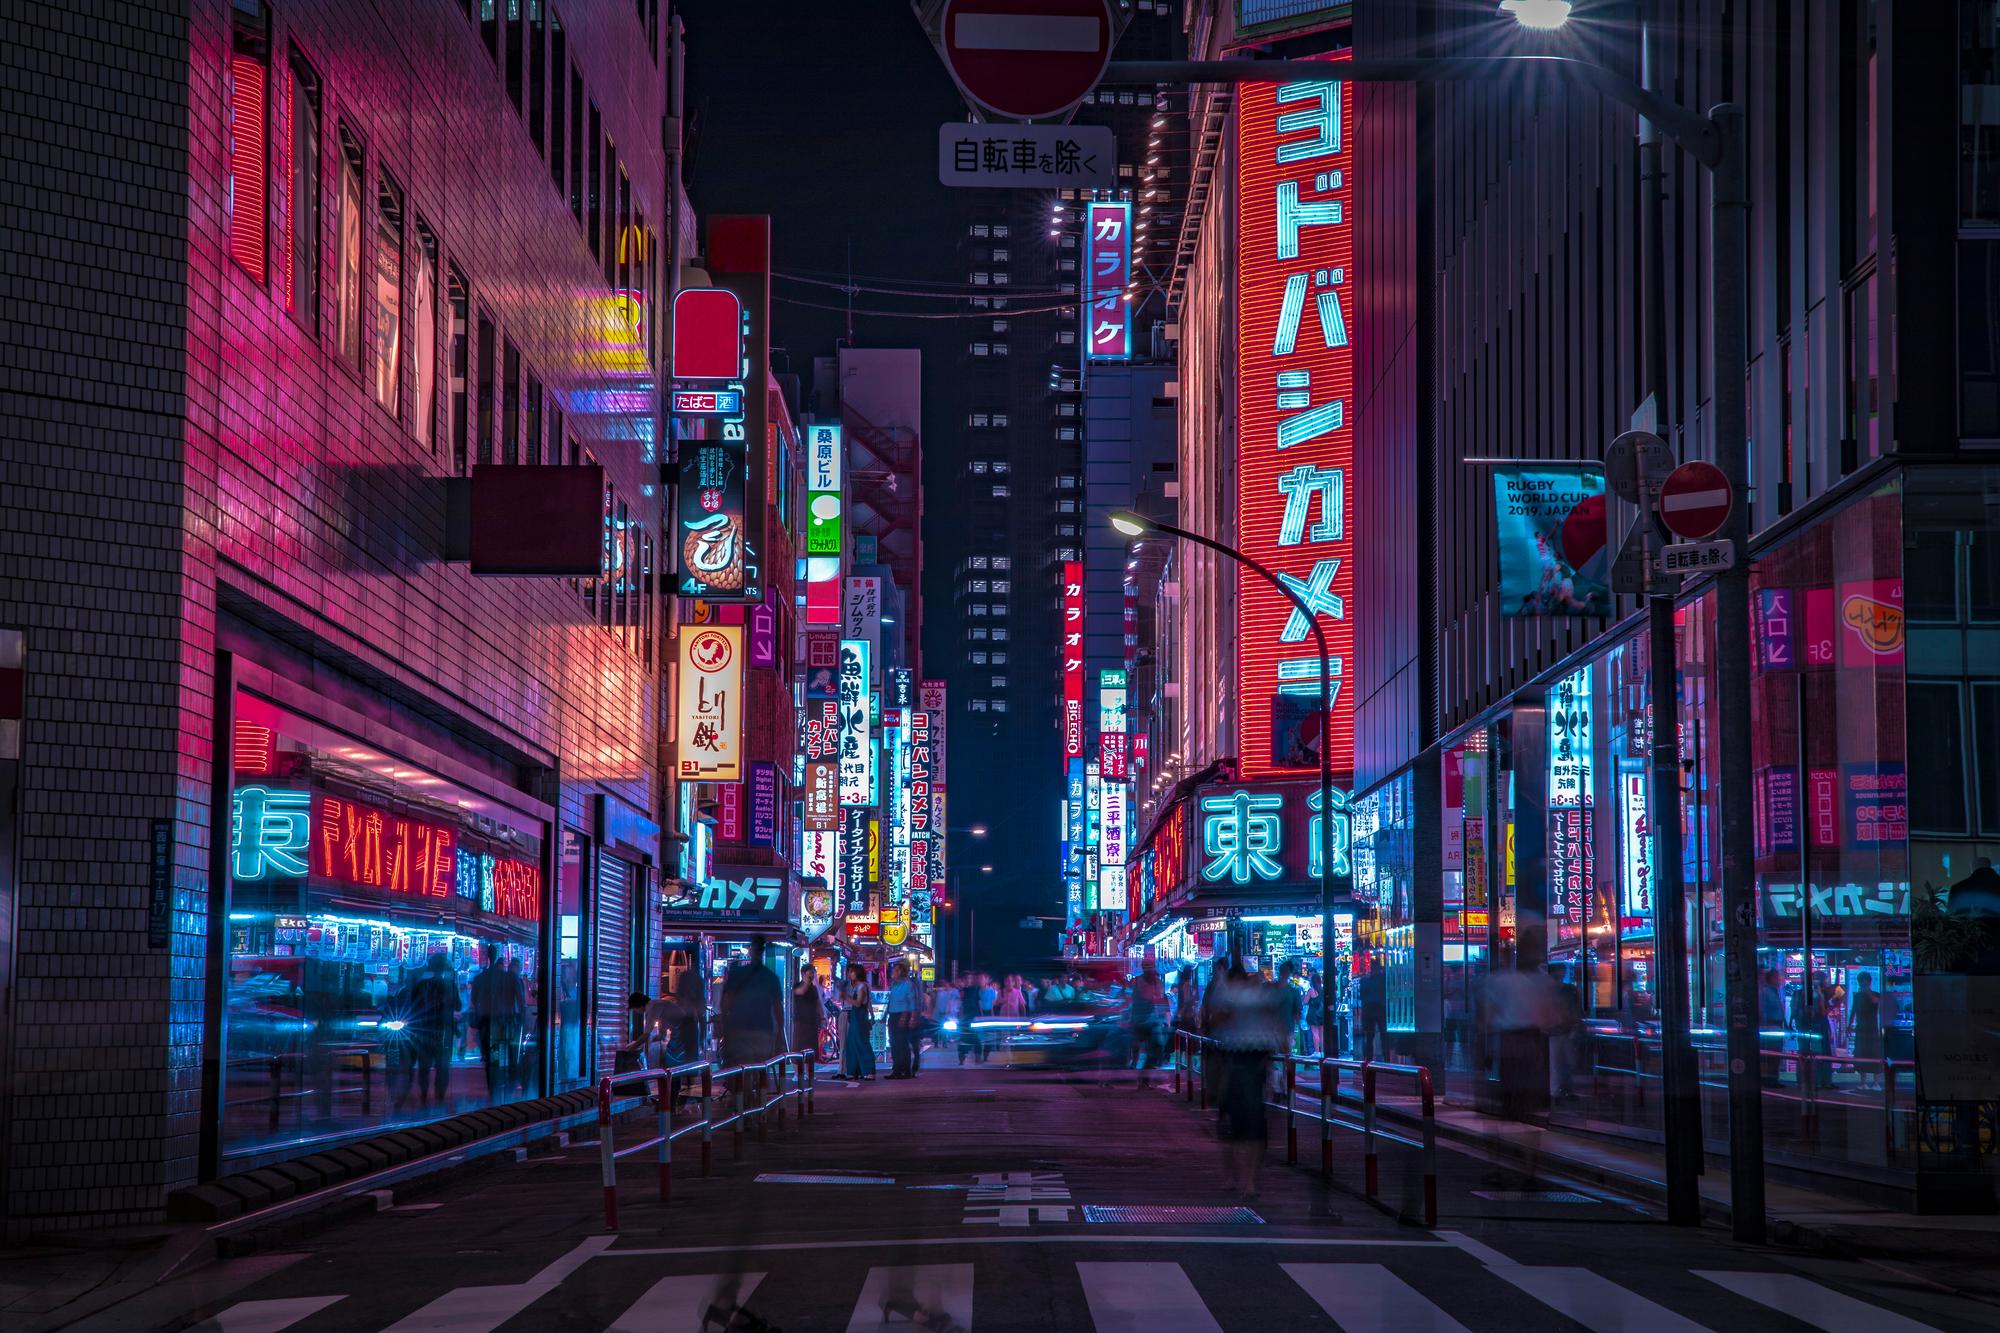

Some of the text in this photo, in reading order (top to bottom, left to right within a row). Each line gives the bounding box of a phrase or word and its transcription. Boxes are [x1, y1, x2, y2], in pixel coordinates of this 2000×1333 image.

[954, 137, 1097, 175] 自転車を除く
[1094, 218, 1124, 345] カラオケ
[677, 396, 715, 409] たばこ
[719, 396, 734, 409] 酒
[817, 428, 832, 488] 桑原ビル
[1507, 481, 1555, 491] RUGBY
[1508, 492, 1590, 503] WORLD CUP
[1544, 505, 1590, 516] JAPAN
[1667, 548, 1729, 569] 自転車を除く
[682, 578, 707, 594] 4F
[1065, 583, 1082, 671] カラオケ
[807, 720, 821, 759] カメラ
[823, 702, 837, 755] ヨドバシ
[1068, 700, 1079, 754] BIG ECHO
[681, 760, 699, 771] B1
[911, 713, 929, 829] ヨドバシカメラ
[851, 809, 865, 912] ケータイアクセサリー館
[911, 840, 928, 890] 時計館
[153, 902, 167, 916] 17
[698, 876, 783, 910] カメラ
